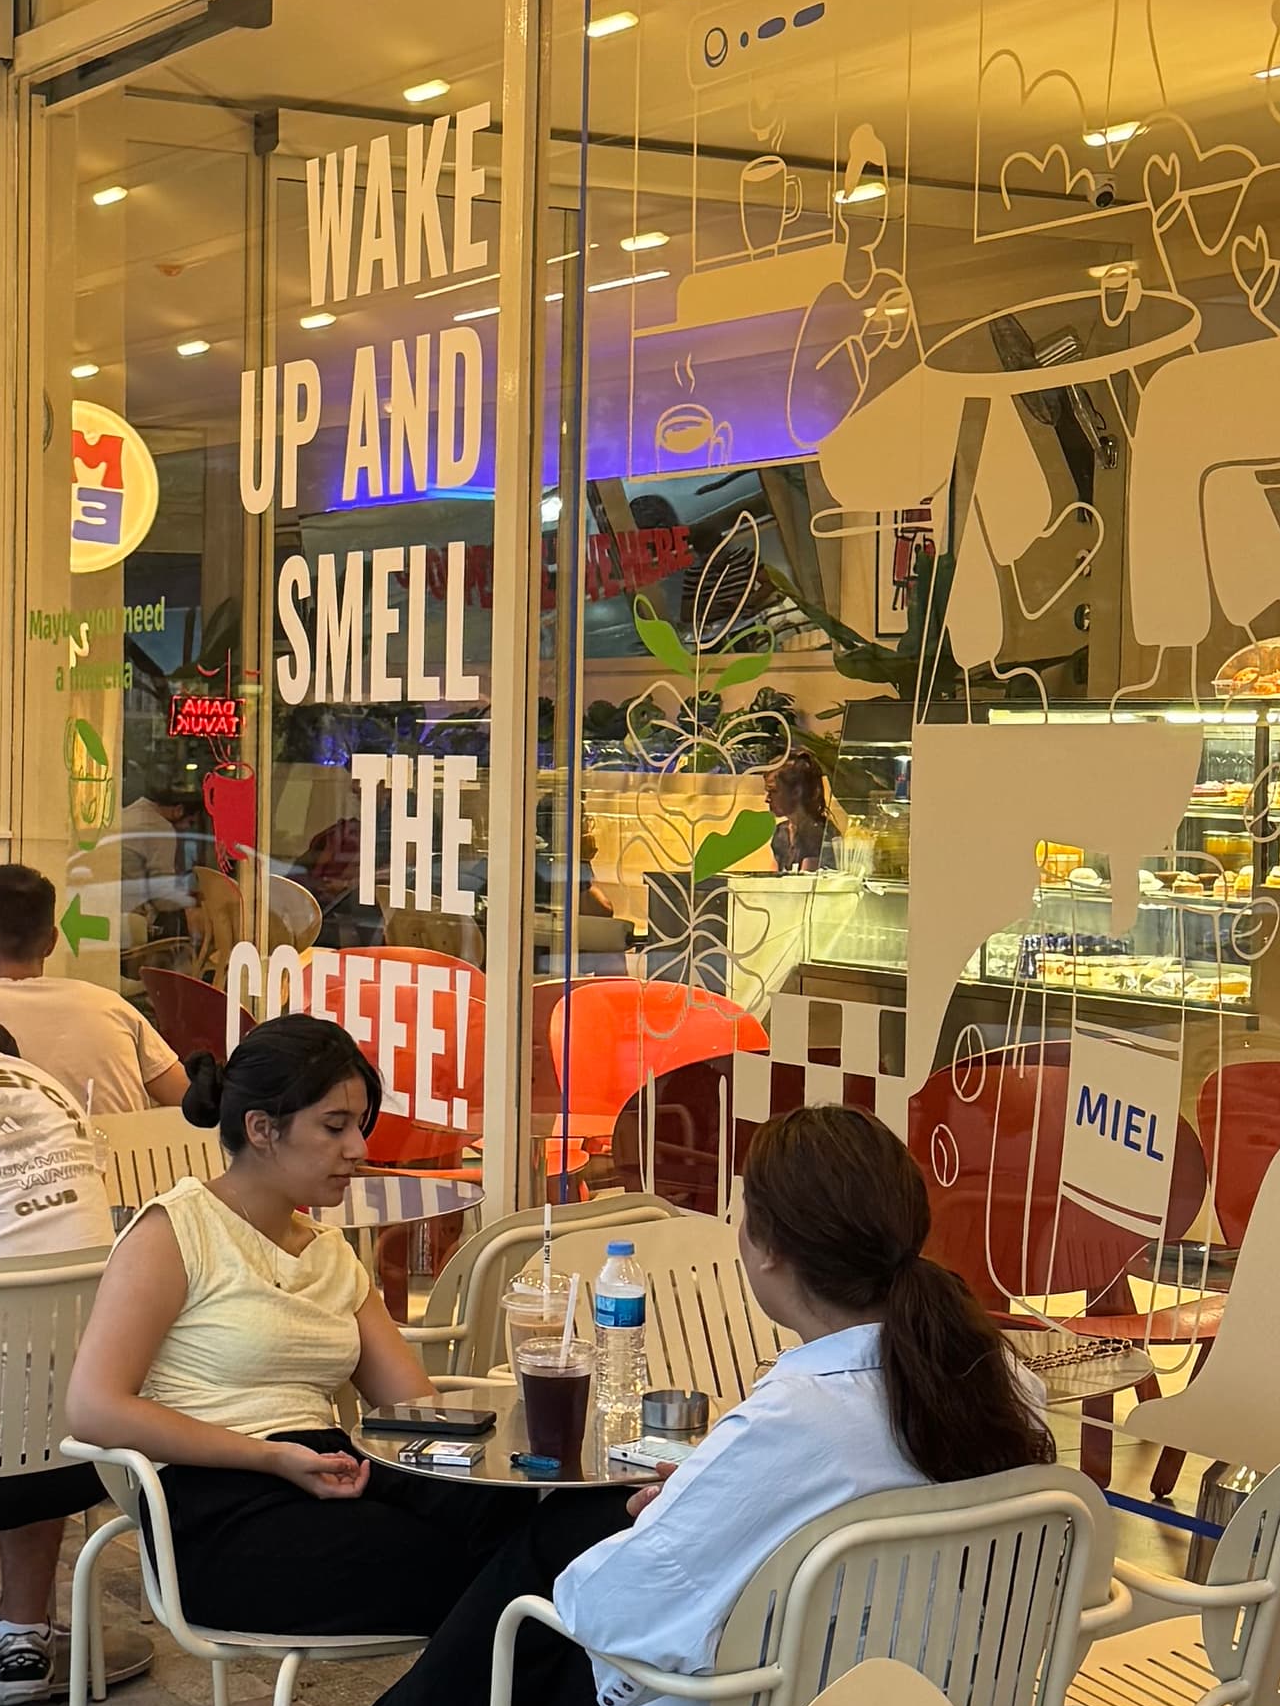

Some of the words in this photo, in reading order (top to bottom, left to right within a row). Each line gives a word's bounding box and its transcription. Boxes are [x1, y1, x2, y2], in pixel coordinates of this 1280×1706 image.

[306, 101, 491, 307] WAKE
[239, 359, 322, 515] UP
[341, 326, 483, 501] AND
[123, 596, 166, 634] need
[276, 540, 481, 706] SMELL
[351, 753, 478, 917] THE
[13, 1188, 79, 1217] CLUB
[1076, 1085, 1164, 1162] MIEL
